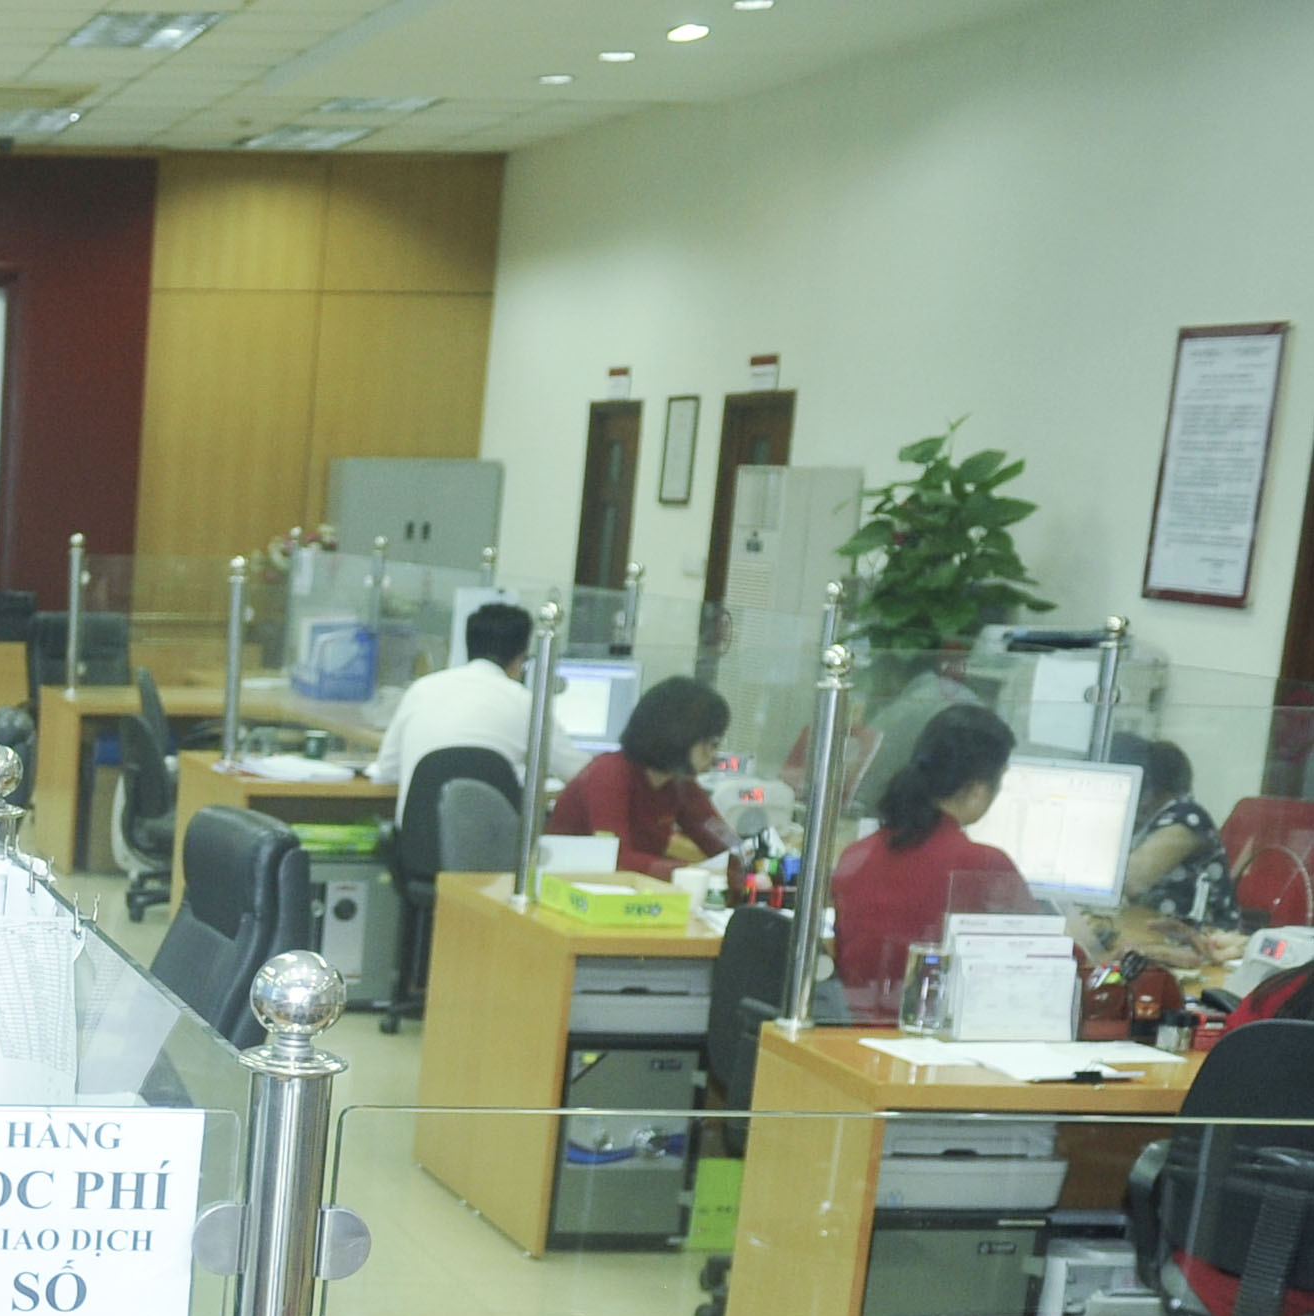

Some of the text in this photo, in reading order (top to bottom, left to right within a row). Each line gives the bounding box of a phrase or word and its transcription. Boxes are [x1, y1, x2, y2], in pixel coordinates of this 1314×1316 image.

[8, 1113, 122, 1149] HÀNG
[74, 1160, 173, 1210] PHÍ
[71, 1229, 154, 1257] DỊCH
[11, 1260, 88, 1312] SỐ
